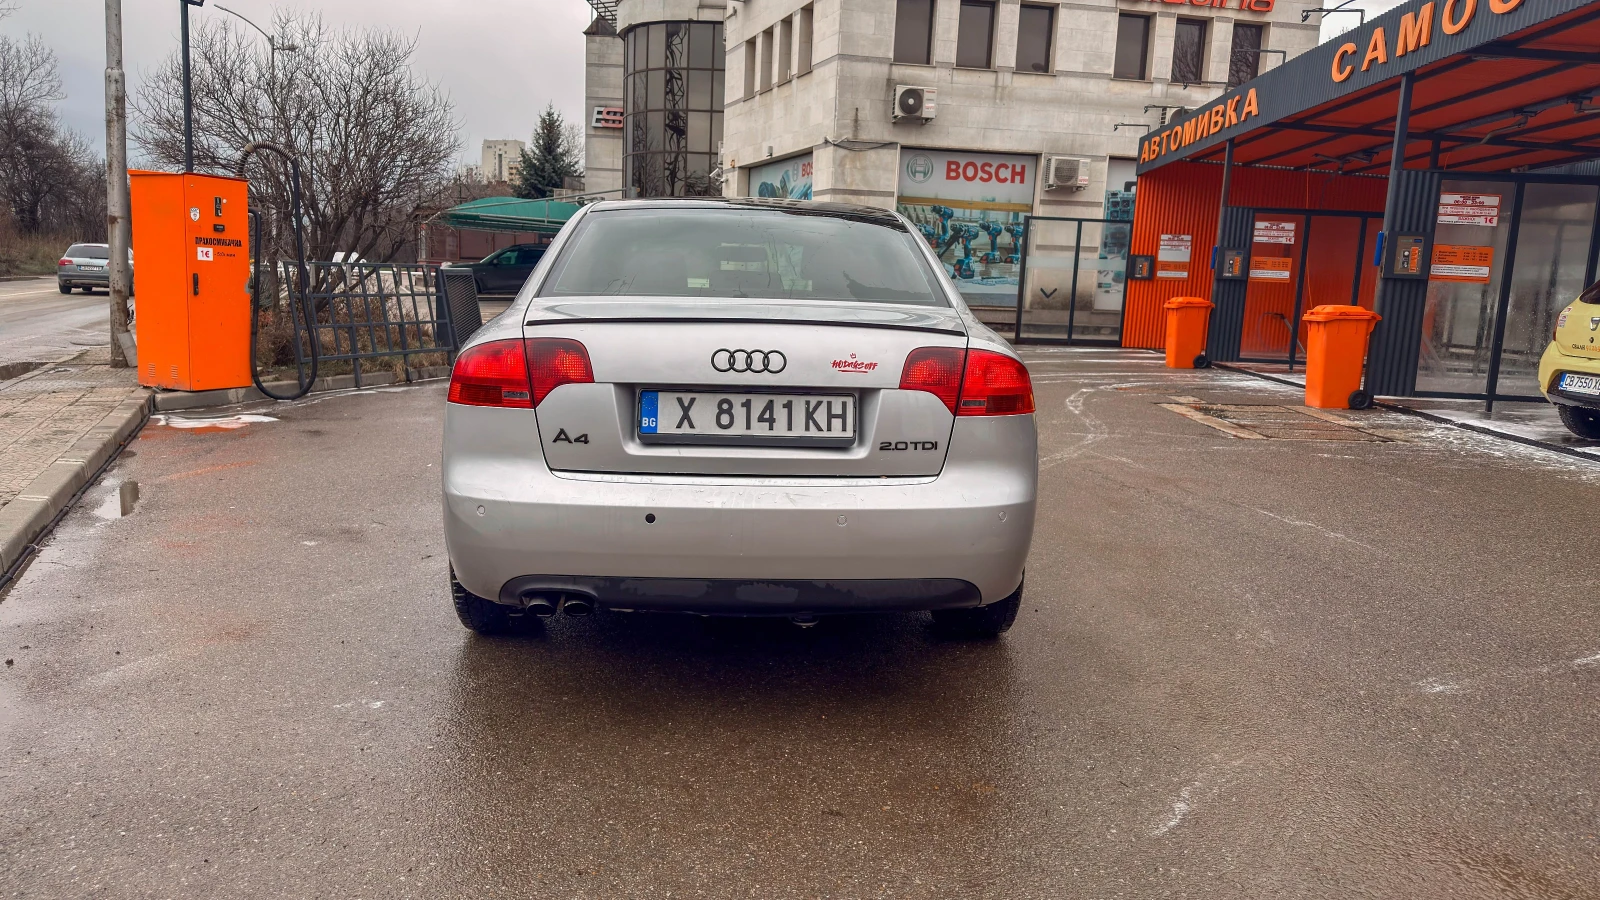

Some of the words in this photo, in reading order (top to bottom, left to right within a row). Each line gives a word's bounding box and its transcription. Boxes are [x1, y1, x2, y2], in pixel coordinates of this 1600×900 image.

[1140, 88, 1259, 164] АВТОМИВКА
[945, 160, 1026, 184] BOSCH
[200, 250, 210, 258] 1€
[641, 417, 656, 427] BG
[675, 396, 697, 429] X
[552, 427, 590, 445] A4
